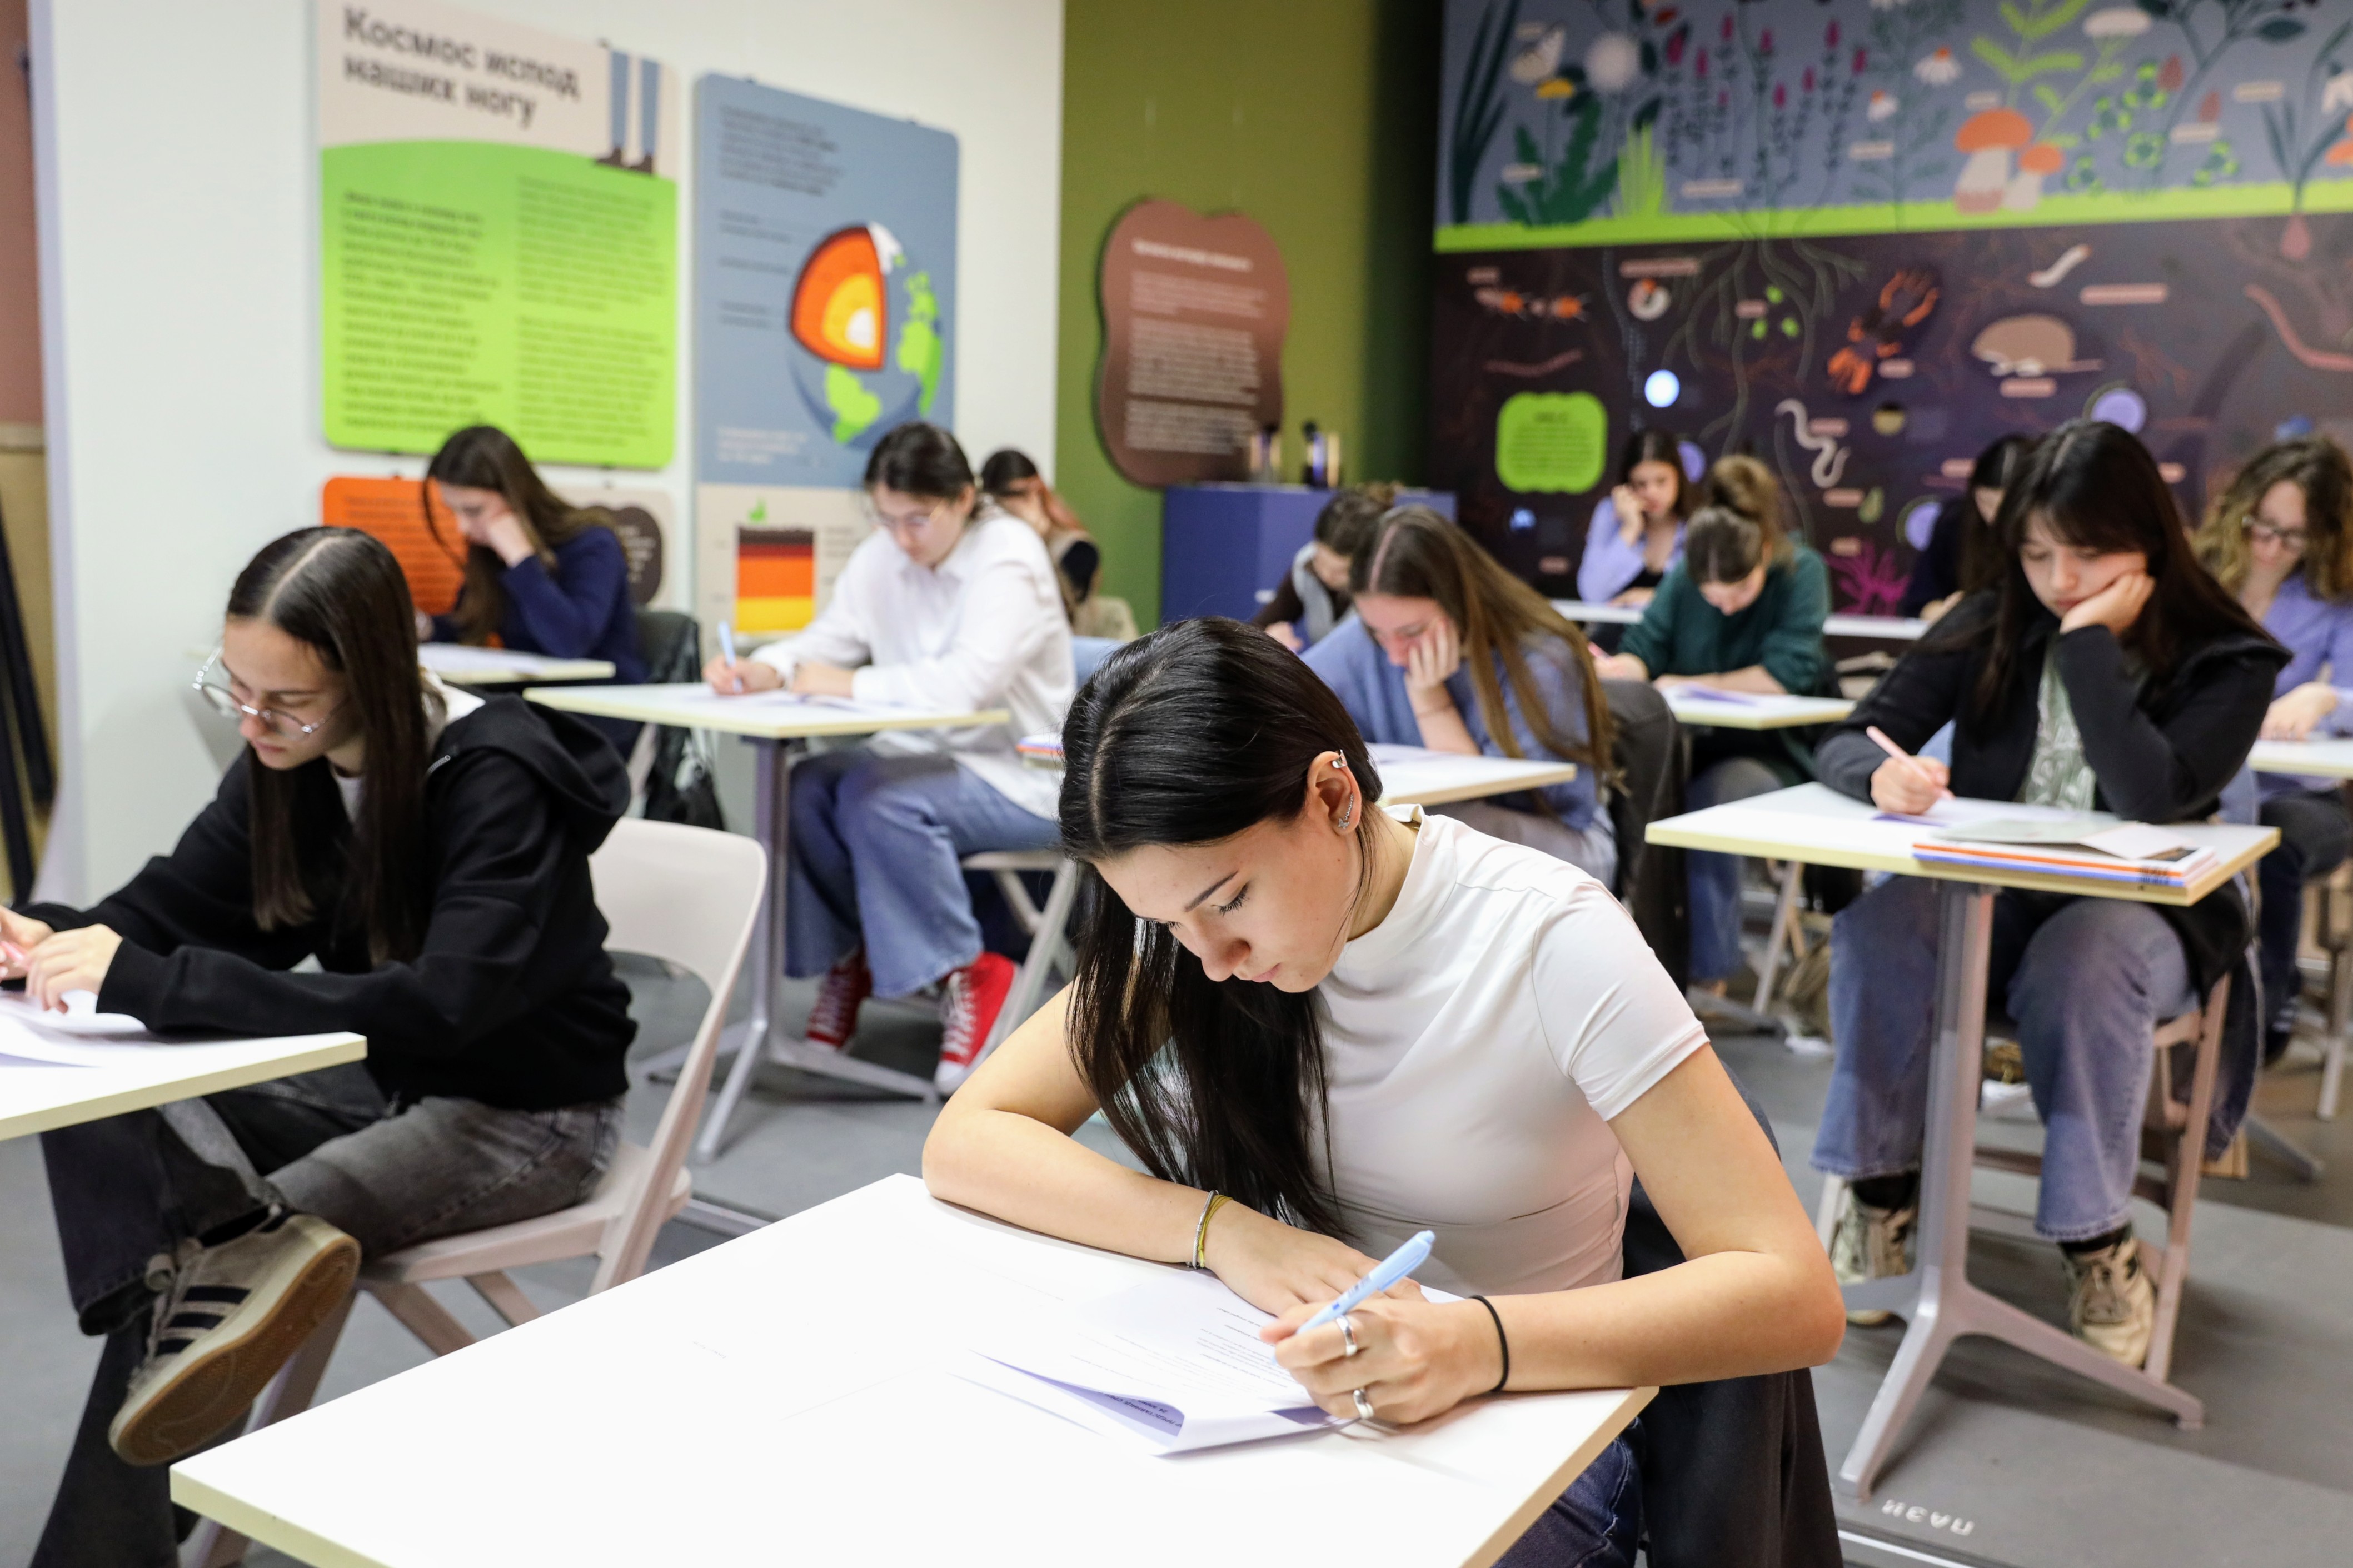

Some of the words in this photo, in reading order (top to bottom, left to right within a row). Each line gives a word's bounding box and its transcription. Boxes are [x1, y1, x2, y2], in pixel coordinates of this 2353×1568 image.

[343, 6, 476, 69] Космос
[482, 52, 581, 102] испод
[1881, 1499, 1975, 1536] ПАЗИ
